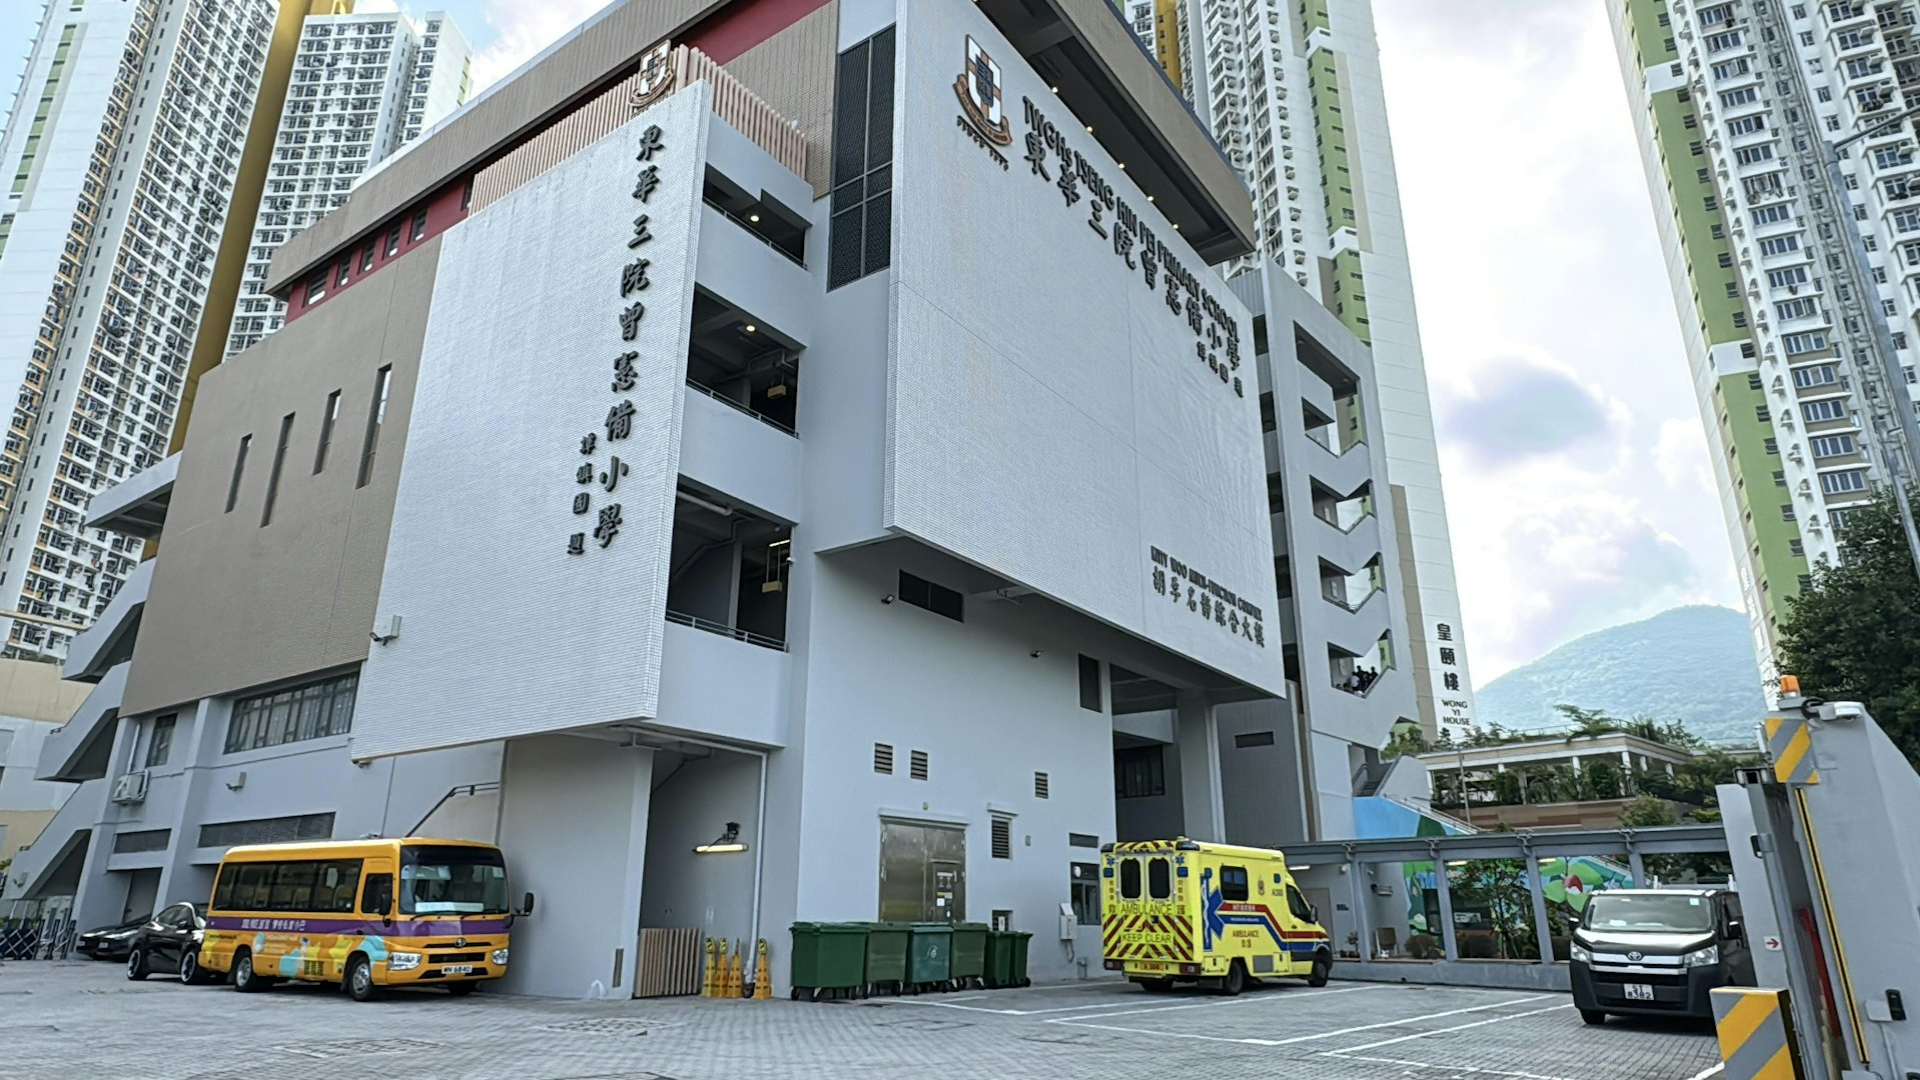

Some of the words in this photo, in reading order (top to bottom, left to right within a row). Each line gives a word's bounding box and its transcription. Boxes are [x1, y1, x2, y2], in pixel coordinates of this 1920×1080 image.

[1022, 95, 1073, 168] TWGHs
[1074, 150, 1115, 211] TSENG
[1116, 196, 1138, 238] HIN
[1139, 220, 1156, 256] PEI
[1157, 240, 1201, 302] PRIMARY
[1201, 288, 1240, 343] SCHOOL
[1169, 556, 1187, 579] WOO
[1437, 623, 1460, 691] 皇頤樓
[1442, 699, 1468, 709] WONG
[1443, 716, 1471, 725] HOUSE
[1121, 903, 1173, 915] AMBULANCE
[1122, 933, 1143, 943] KEEP
[1145, 934, 1172, 943] CLEAR
[1232, 930, 1260, 938] AMBULANCE
